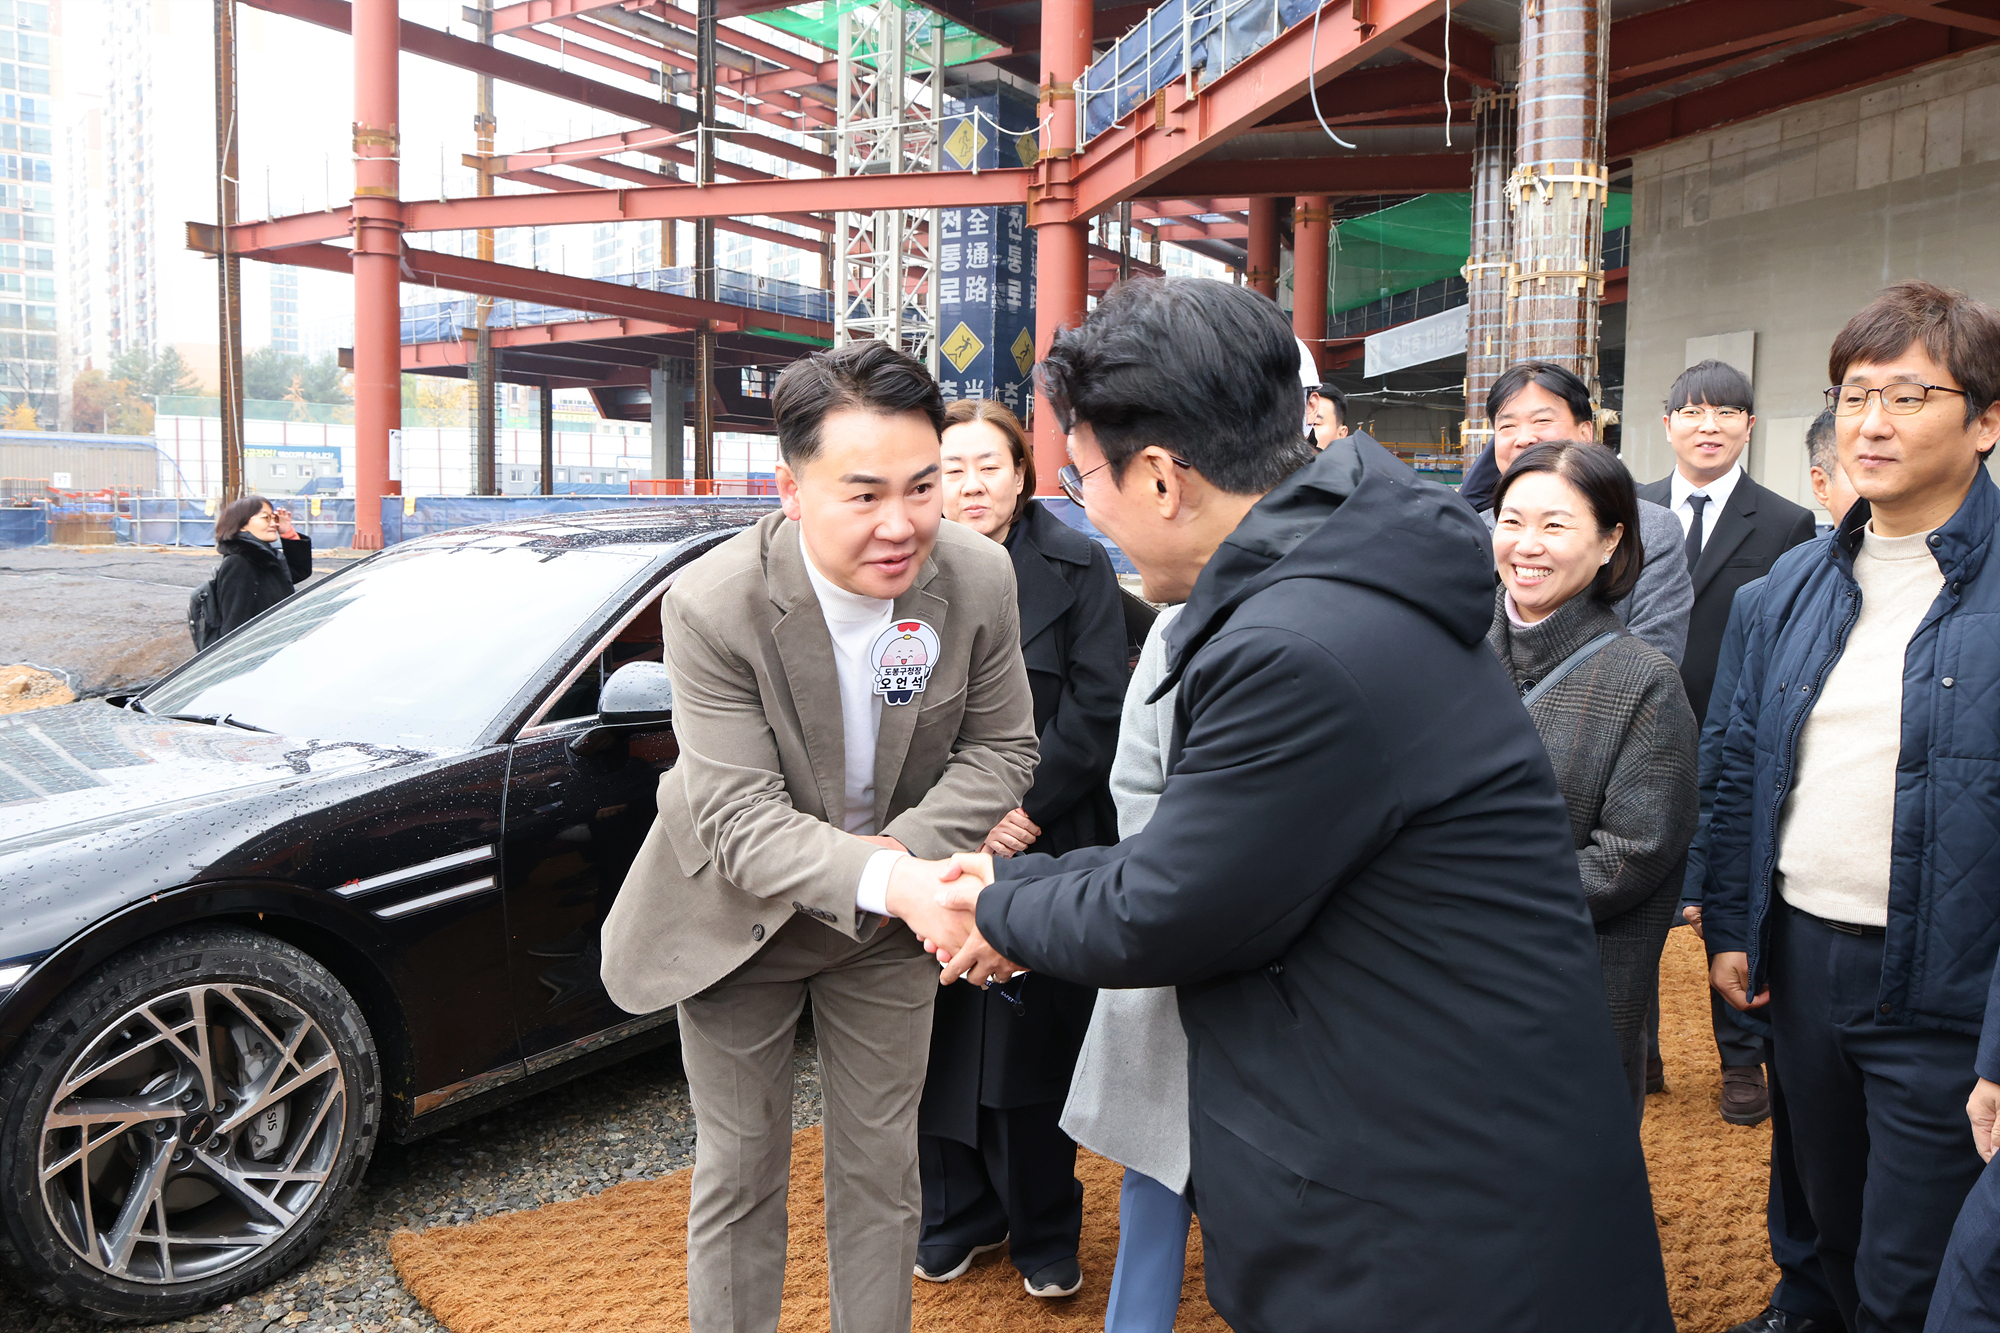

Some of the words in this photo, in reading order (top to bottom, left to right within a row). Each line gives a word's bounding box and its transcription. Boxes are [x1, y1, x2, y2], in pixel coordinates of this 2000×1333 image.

[965, 208, 989, 303] 全通路
[884, 666, 922, 676] 도봉구청장
[879, 676, 923, 690] 오언석
